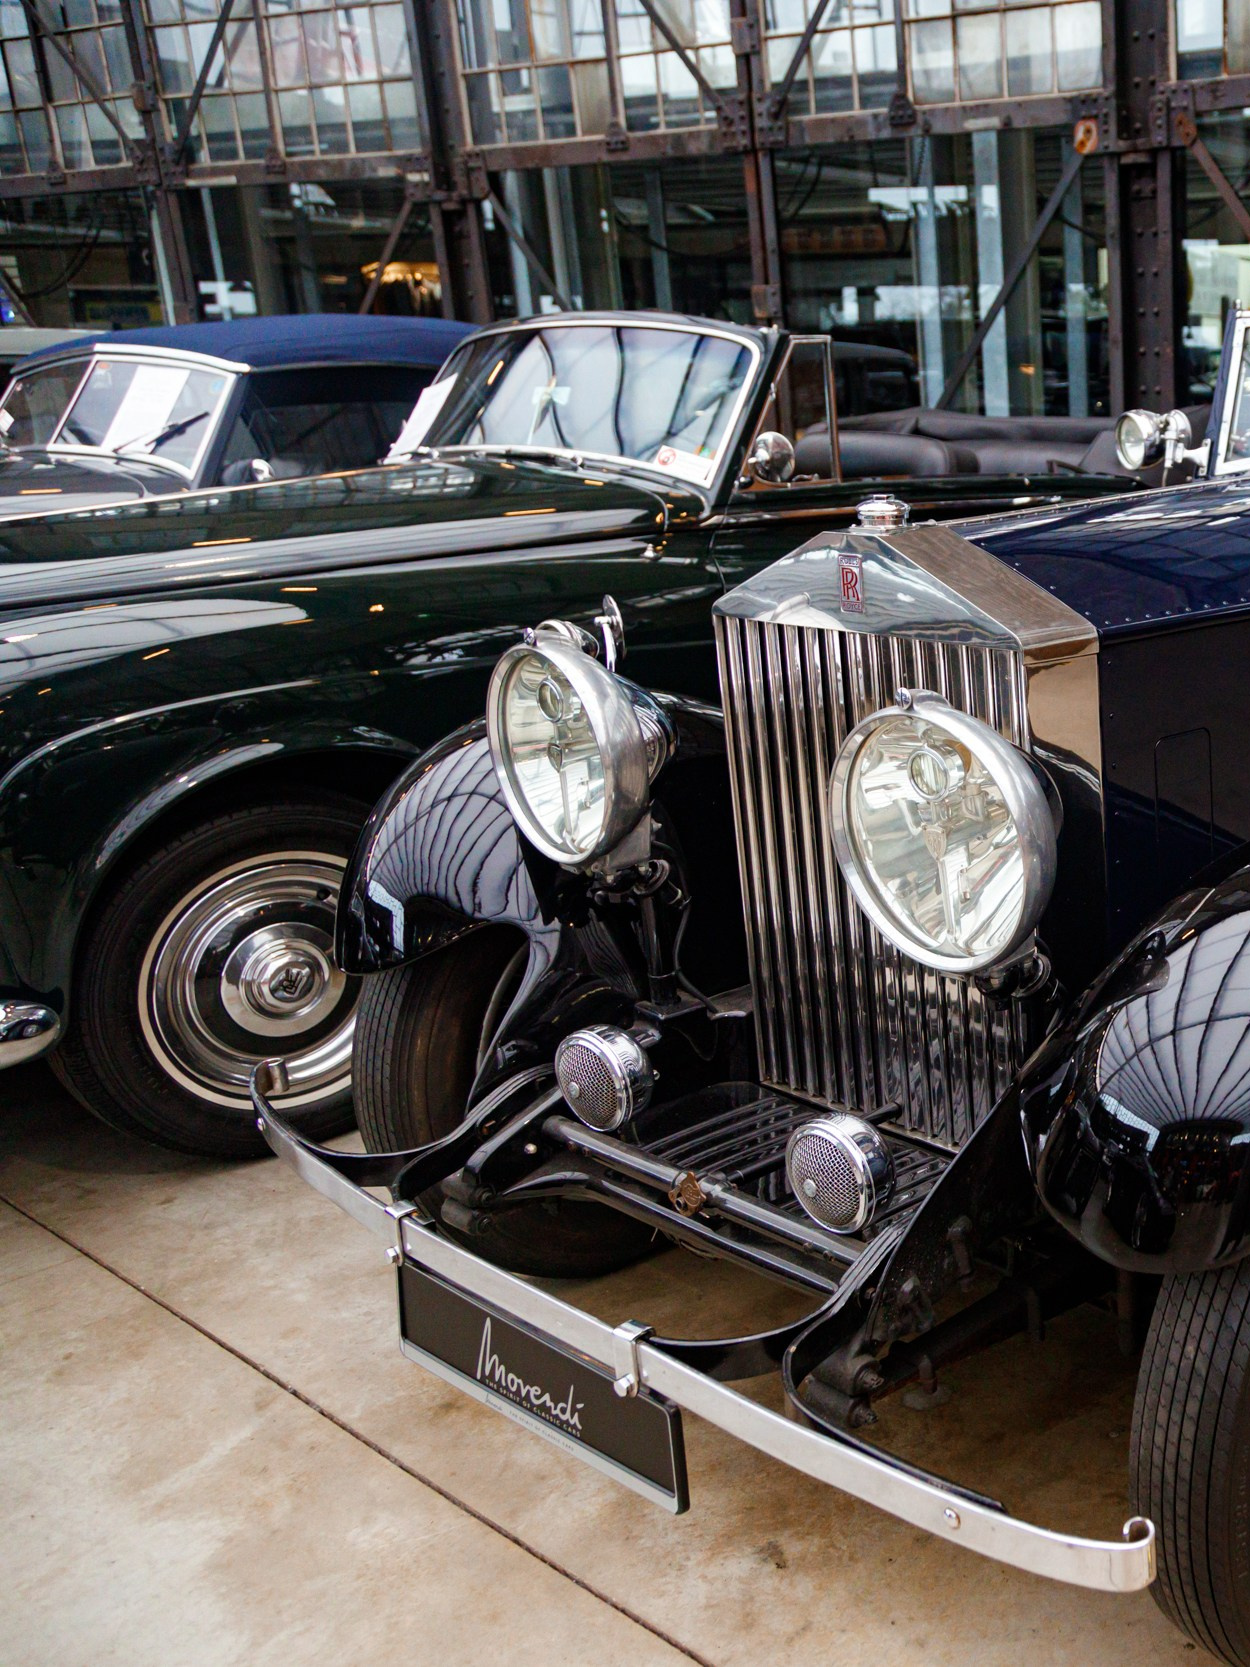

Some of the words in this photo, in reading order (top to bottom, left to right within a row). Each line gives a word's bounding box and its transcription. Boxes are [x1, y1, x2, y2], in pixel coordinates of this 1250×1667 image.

[840, 557, 860, 566] ROLLS
[842, 602, 861, 611] ROYCE
[477, 1317, 584, 1430] Movendi
[485, 1379, 497, 1389] THE
[499, 1384, 520, 1402] SPIRIT
[522, 1400, 531, 1409] OF
[533, 1406, 561, 1426] CLASSIC
[563, 1423, 581, 1438] CARS
